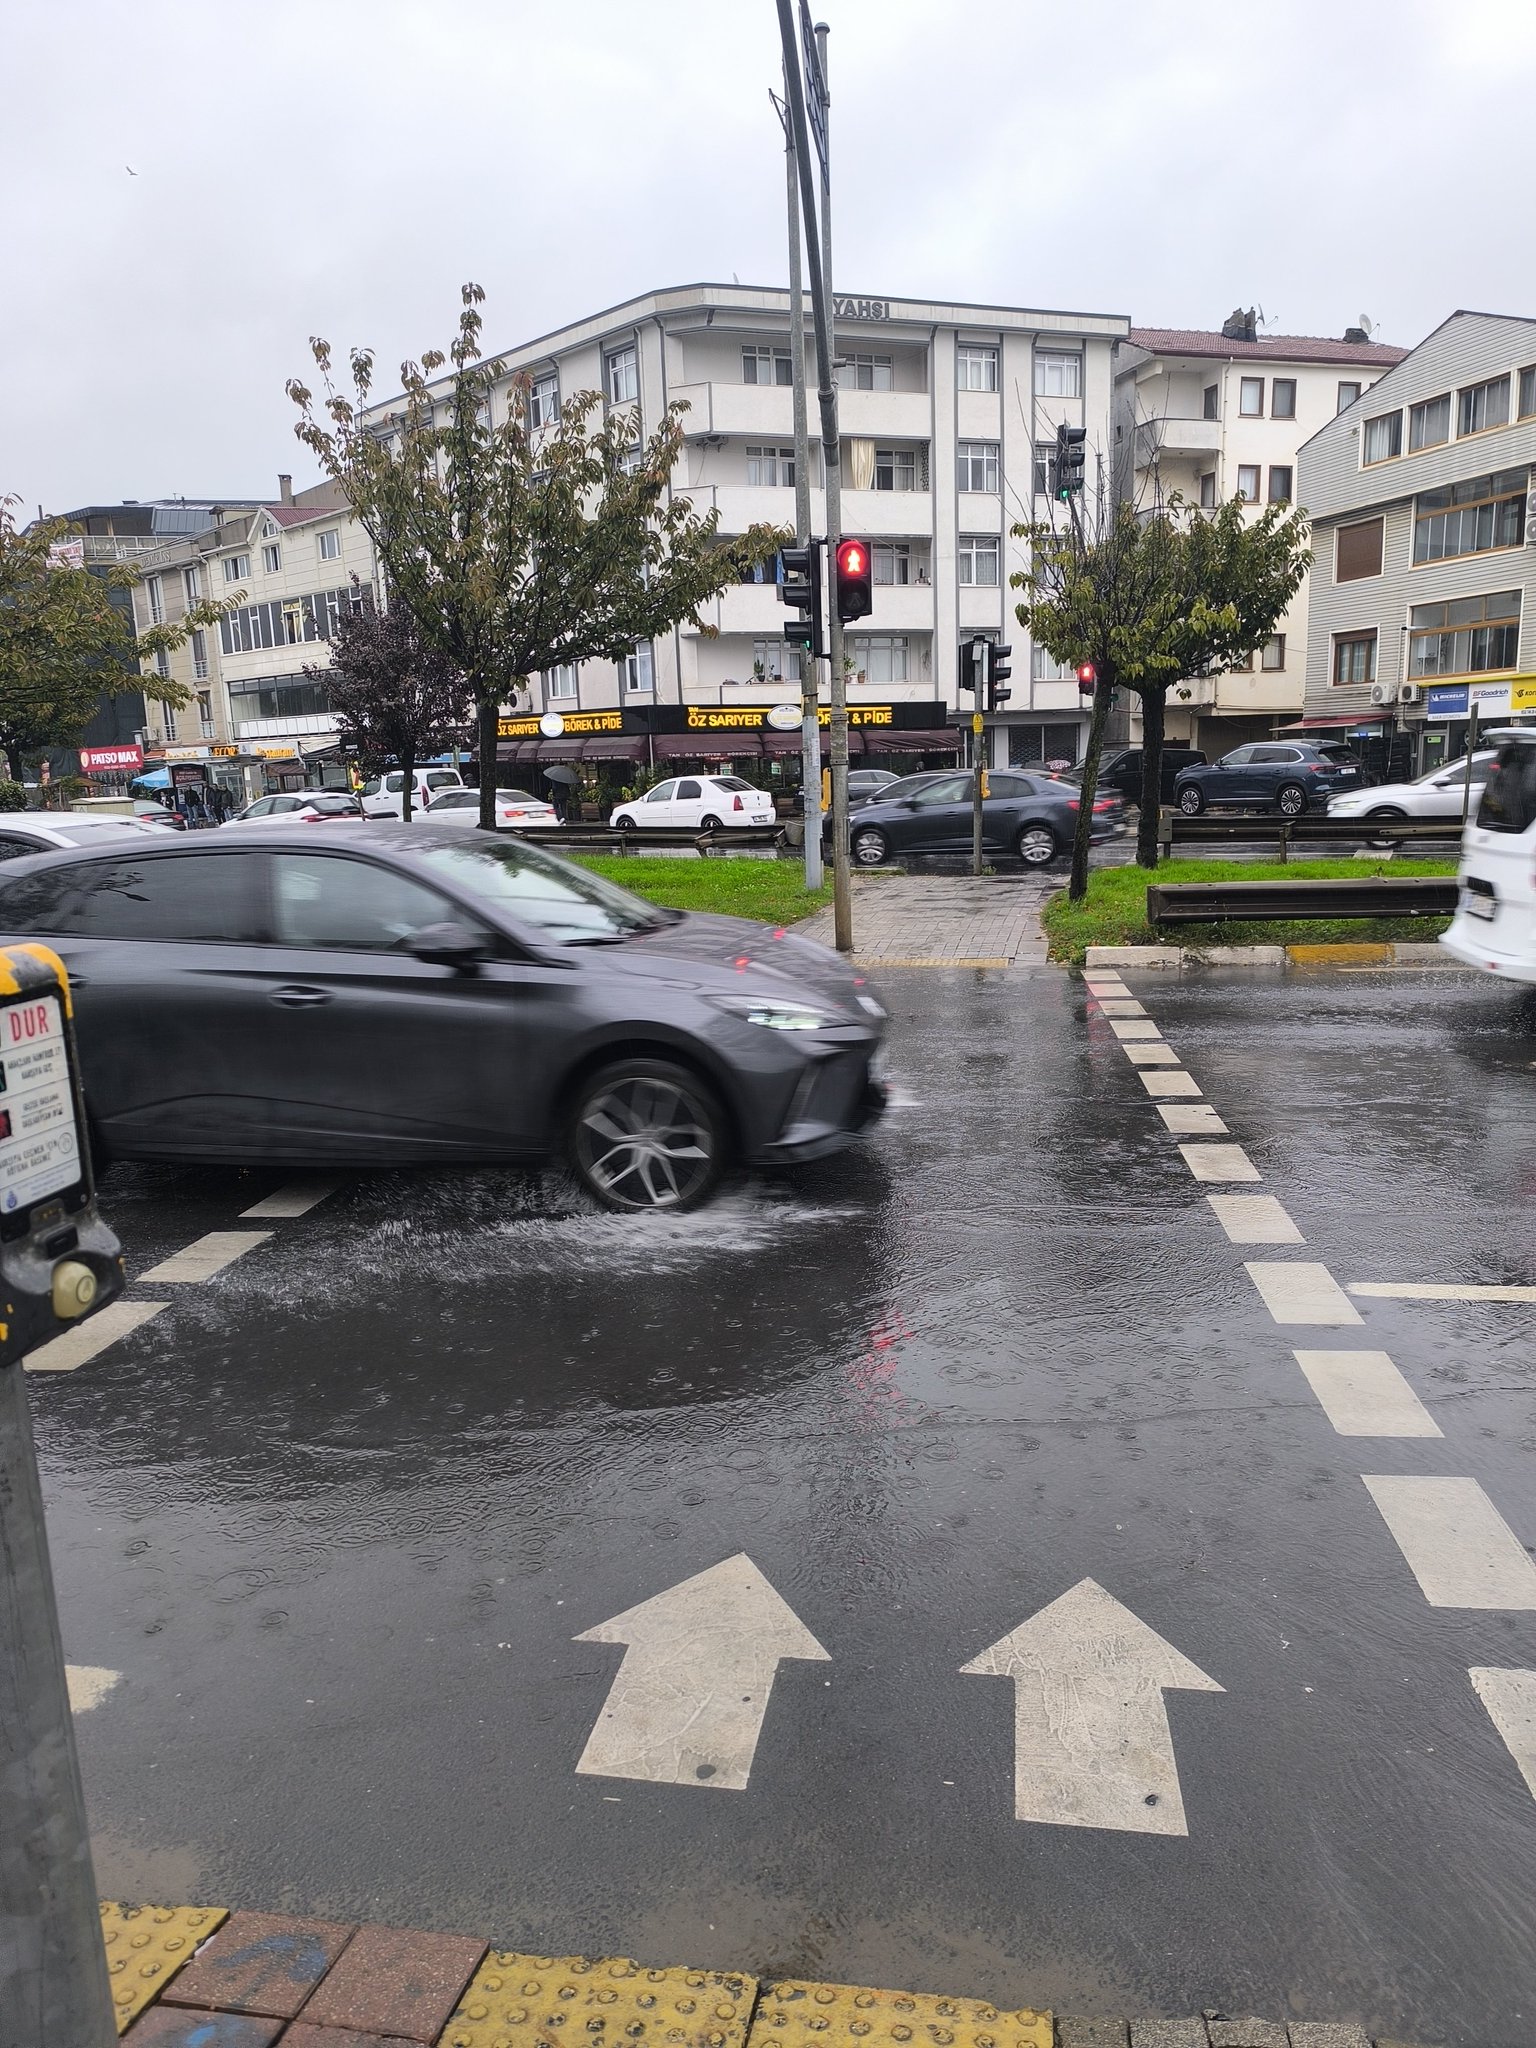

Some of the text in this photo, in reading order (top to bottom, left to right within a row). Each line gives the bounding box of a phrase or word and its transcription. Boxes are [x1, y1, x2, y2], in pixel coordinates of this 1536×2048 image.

[1472, 688, 1509, 697] BFGoodrich
[564, 716, 623, 732] BÖREK & PİDE
[688, 712, 763, 727] ÖZ SARIYER
[852, 713, 862, 724] &
[864, 711, 893, 724] PİDE
[507, 723, 539, 736] SARIYER
[90, 750, 139, 765] PATSO MAX
[9, 1004, 49, 1042] DUR
